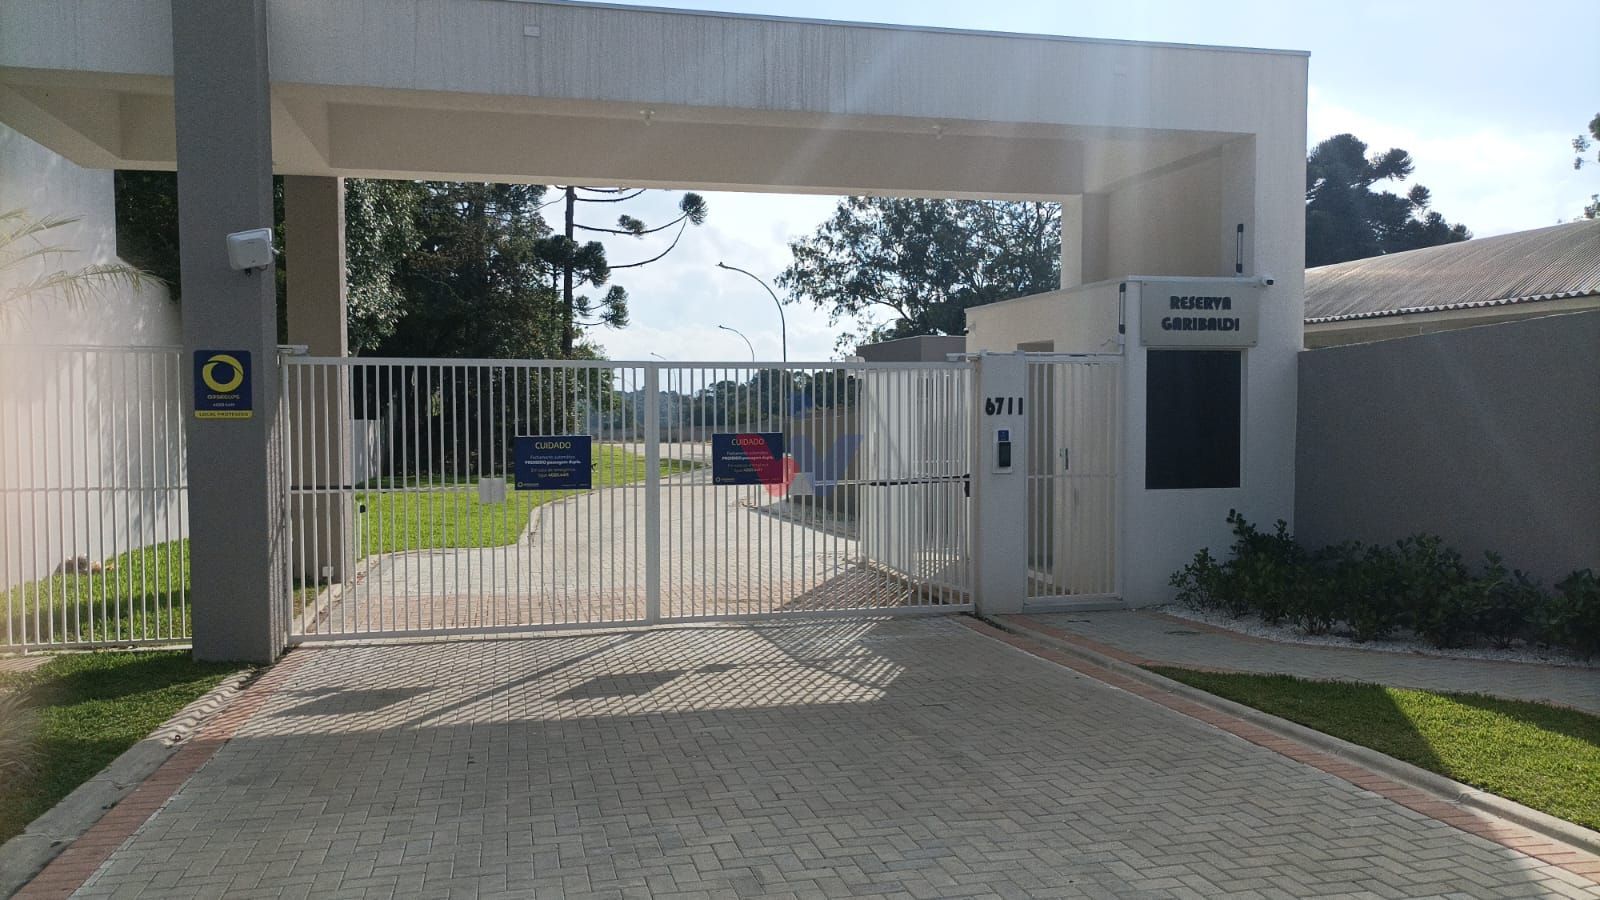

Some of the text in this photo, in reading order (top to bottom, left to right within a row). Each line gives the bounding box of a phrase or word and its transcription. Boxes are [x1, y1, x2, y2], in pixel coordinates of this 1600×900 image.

[1170, 295, 1232, 310] RESERVA
[1161, 316, 1240, 331] GARIBALDI
[985, 397, 1023, 415] 6711
[535, 441, 571, 449] CUIDADO
[731, 438, 765, 446] CUIDADO
